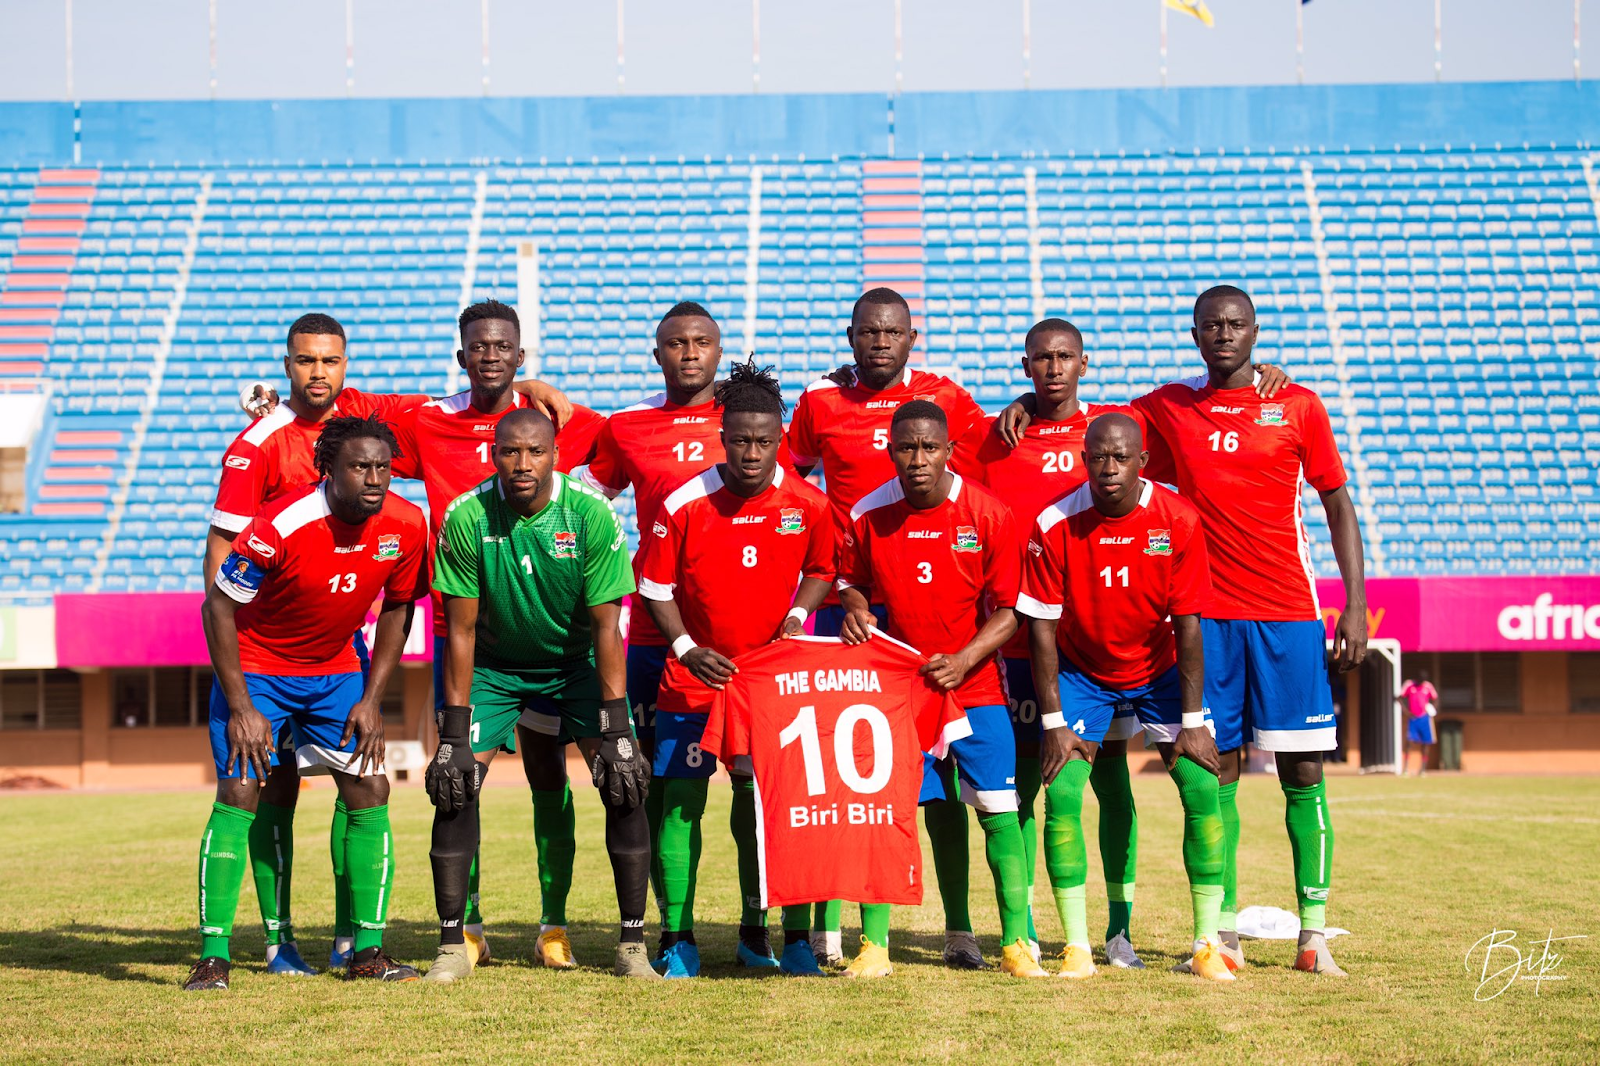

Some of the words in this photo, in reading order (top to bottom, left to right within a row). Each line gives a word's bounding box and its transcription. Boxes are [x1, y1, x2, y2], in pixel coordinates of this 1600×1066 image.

[866, 400, 900, 409] saller
[1210, 405, 1245, 415] saller
[473, 420, 496, 430] sall
[673, 416, 709, 425] saller
[1038, 425, 1073, 435] saller
[873, 428, 889, 450] 5
[1208, 431, 1239, 452] 16
[476, 442, 492, 463] 1
[672, 441, 704, 462] 12
[1041, 451, 1074, 473] 20
[732, 515, 767, 525] saller
[907, 530, 943, 539] saller
[1099, 536, 1135, 545] saller
[334, 544, 367, 554] saller
[742, 545, 758, 568] 8
[521, 554, 533, 575] 1
[916, 562, 933, 584] 3
[328, 572, 357, 593] 13
[1099, 566, 1129, 587] 11
[775, 671, 810, 696] THE
[814, 669, 882, 693] GAMBIA
[1305, 713, 1335, 724] saller
[470, 722, 480, 743] 1
[686, 742, 703, 768] 8
[779, 704, 893, 796] 10
[789, 804, 838, 828] Biri
[847, 803, 894, 826] Biri
